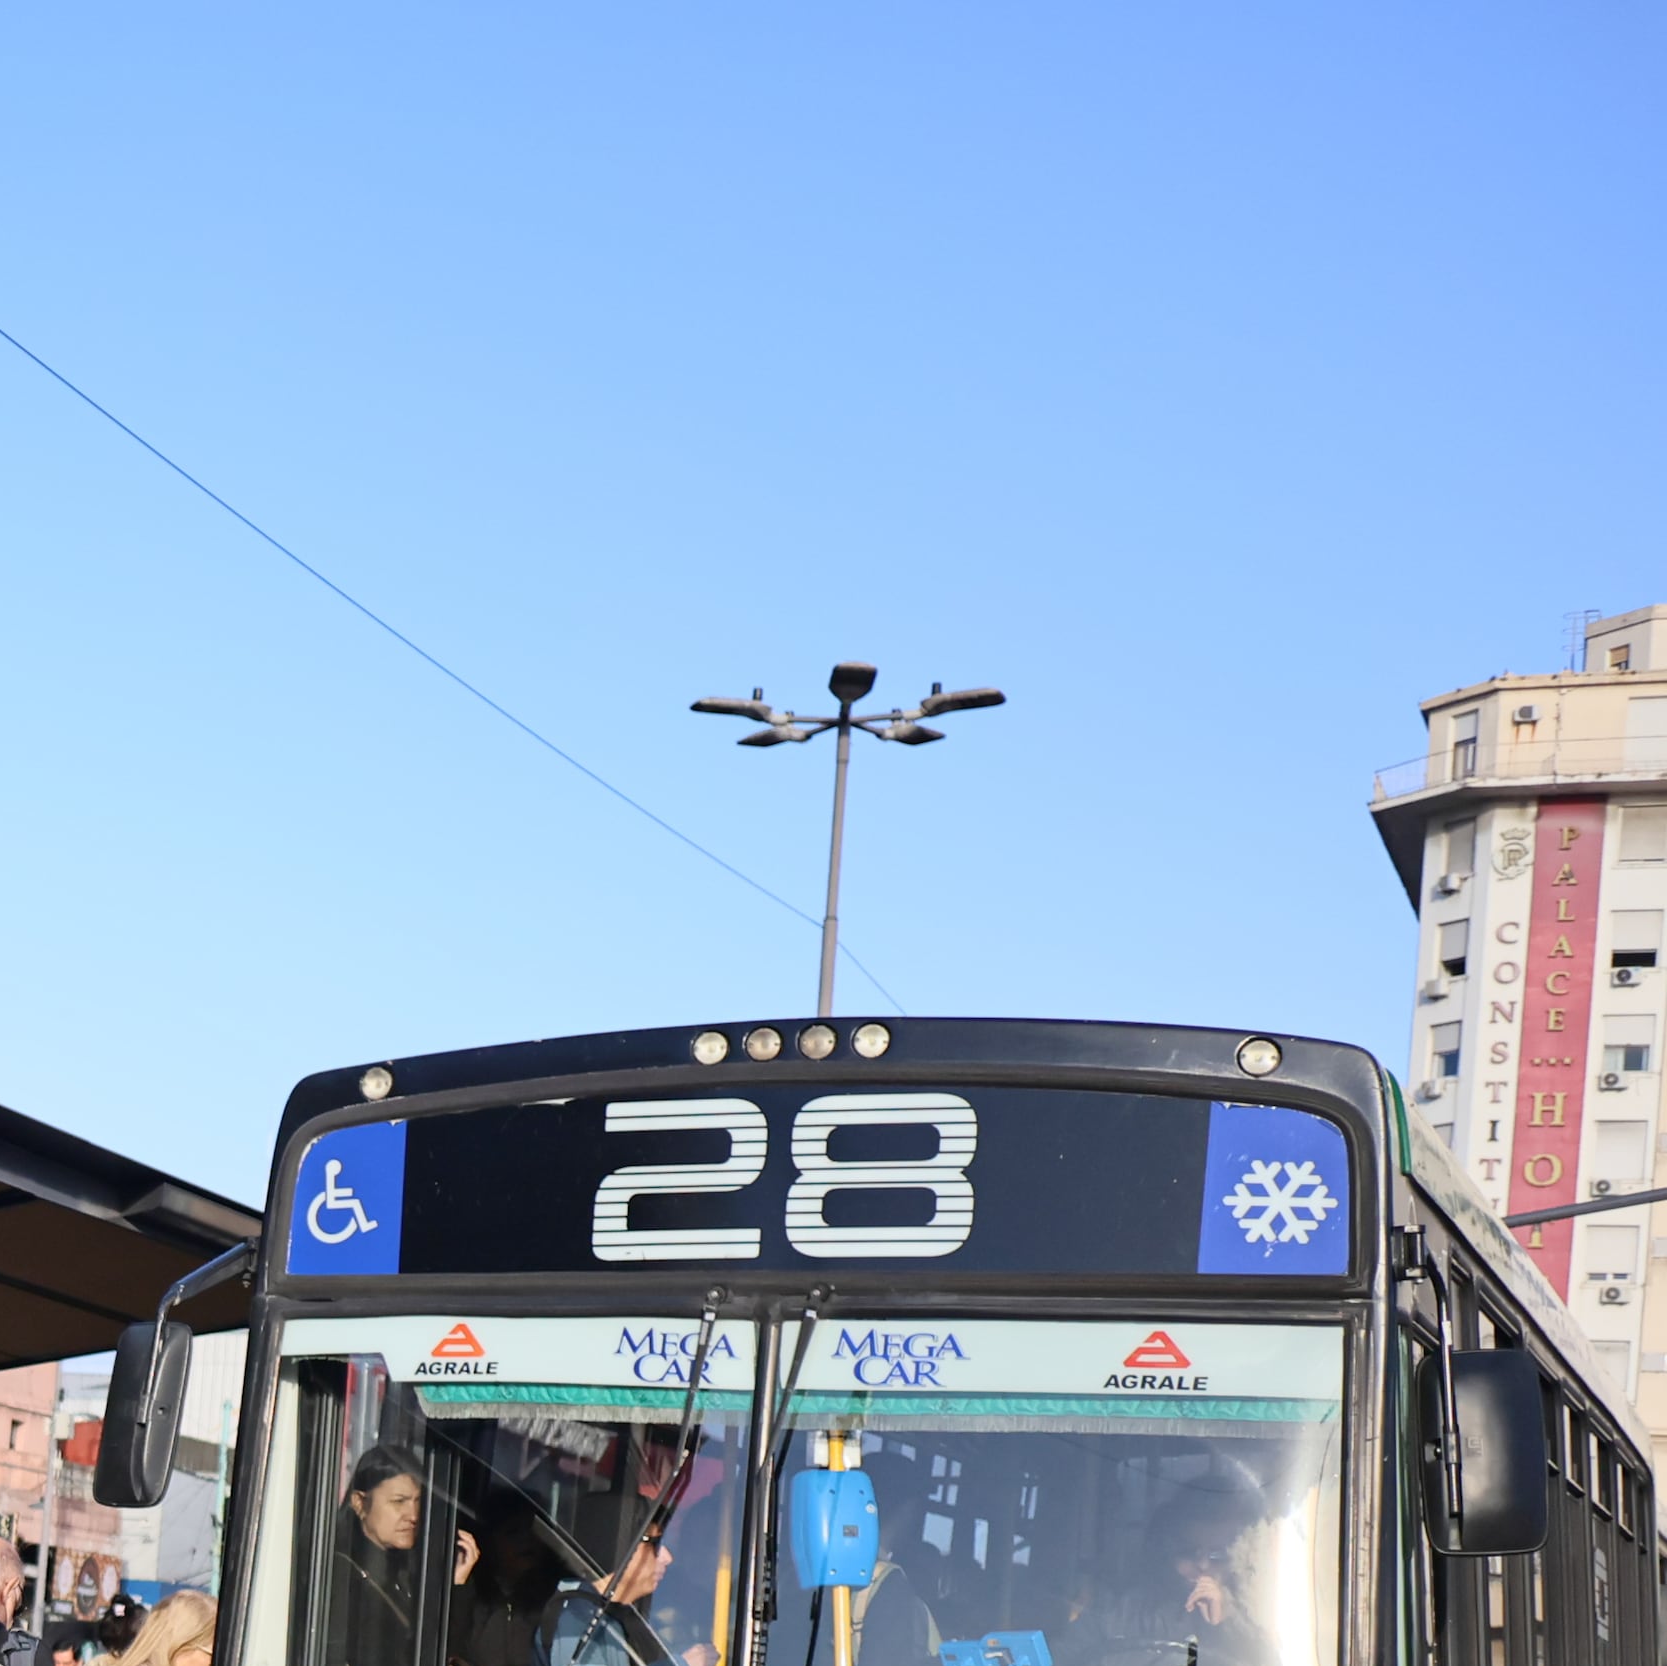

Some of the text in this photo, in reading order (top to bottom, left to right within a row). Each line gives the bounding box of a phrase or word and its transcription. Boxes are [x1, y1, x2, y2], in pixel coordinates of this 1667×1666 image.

[1544, 826, 1581, 1032] PALACE
[1479, 921, 1520, 1209] CONSTIT
[592, 1093, 977, 1262] 28
[831, 1327, 970, 1360] MEGA
[414, 1361, 499, 1375] AGRALE
[853, 1356, 946, 1387] CAR
[1103, 1373, 1209, 1391] AGRALE
